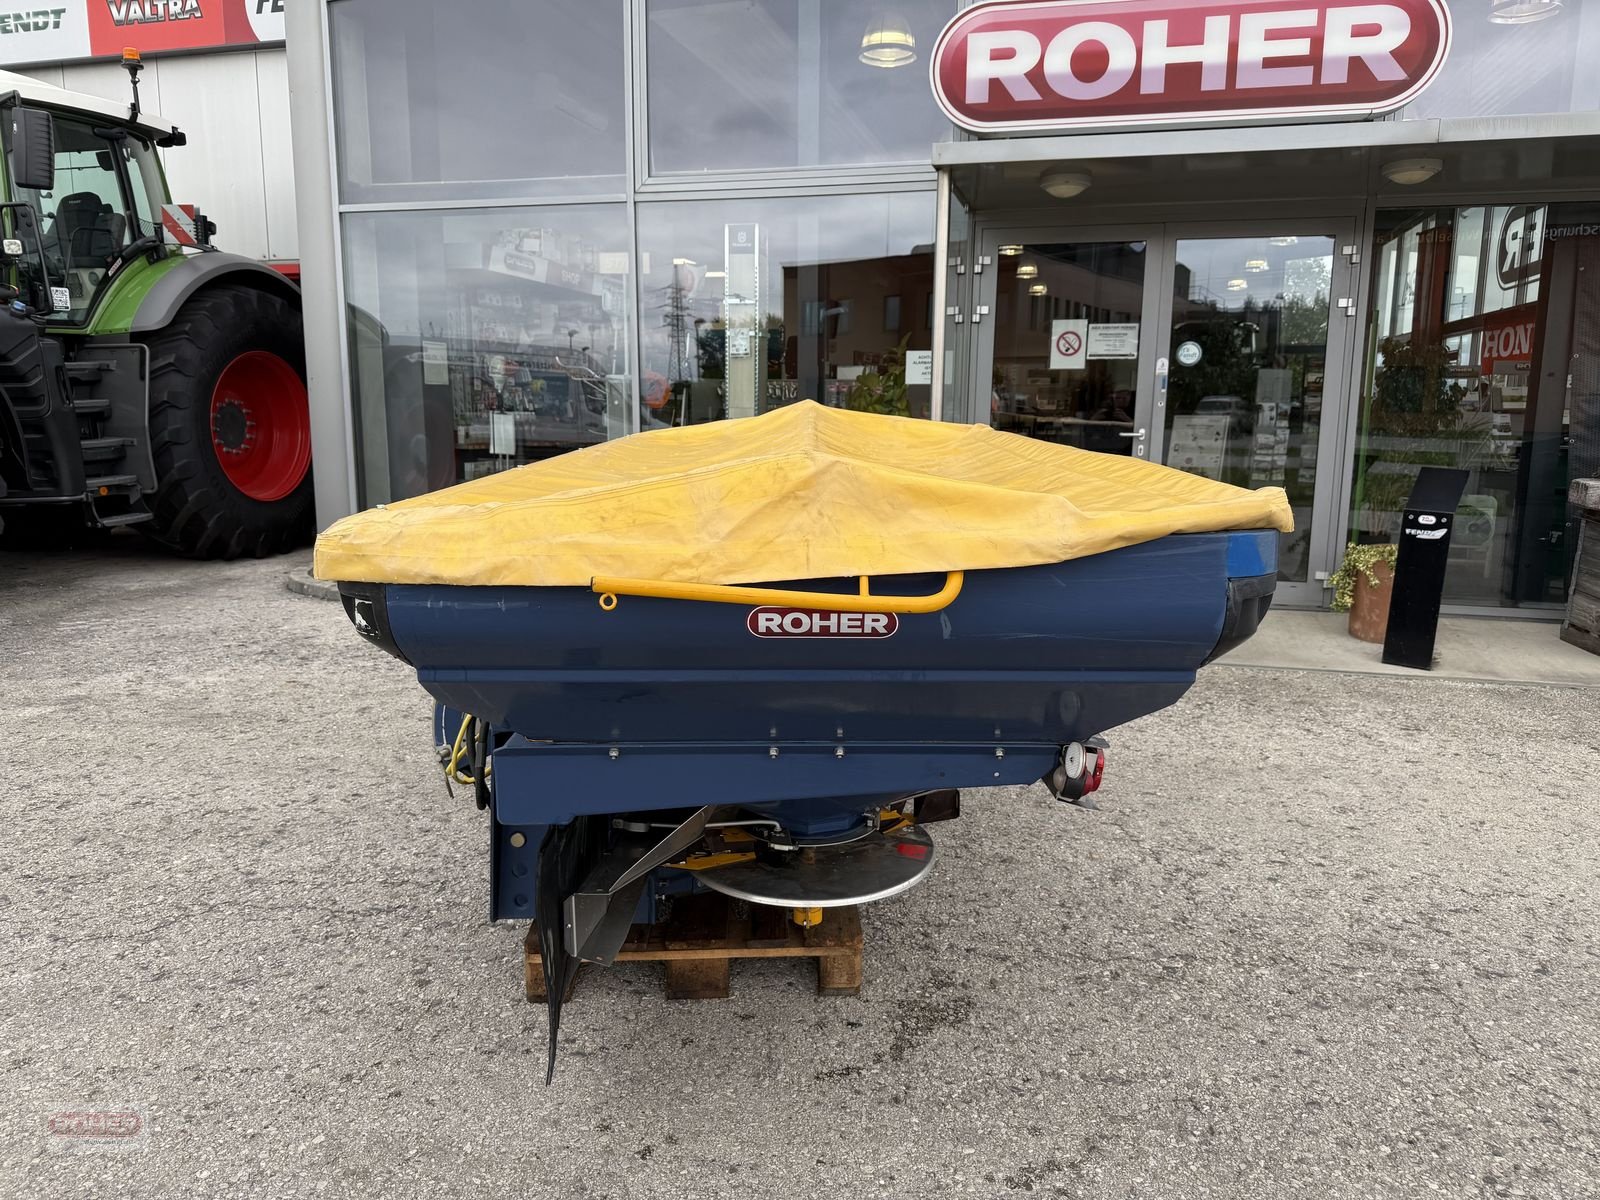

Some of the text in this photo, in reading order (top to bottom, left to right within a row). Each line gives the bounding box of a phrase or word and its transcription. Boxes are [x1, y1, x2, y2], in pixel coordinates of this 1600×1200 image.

[107, 0, 202, 26] VALTRA
[965, 4, 1409, 104] ROHER
[1483, 323, 1535, 358] HON
[757, 612, 889, 634] ROHER
